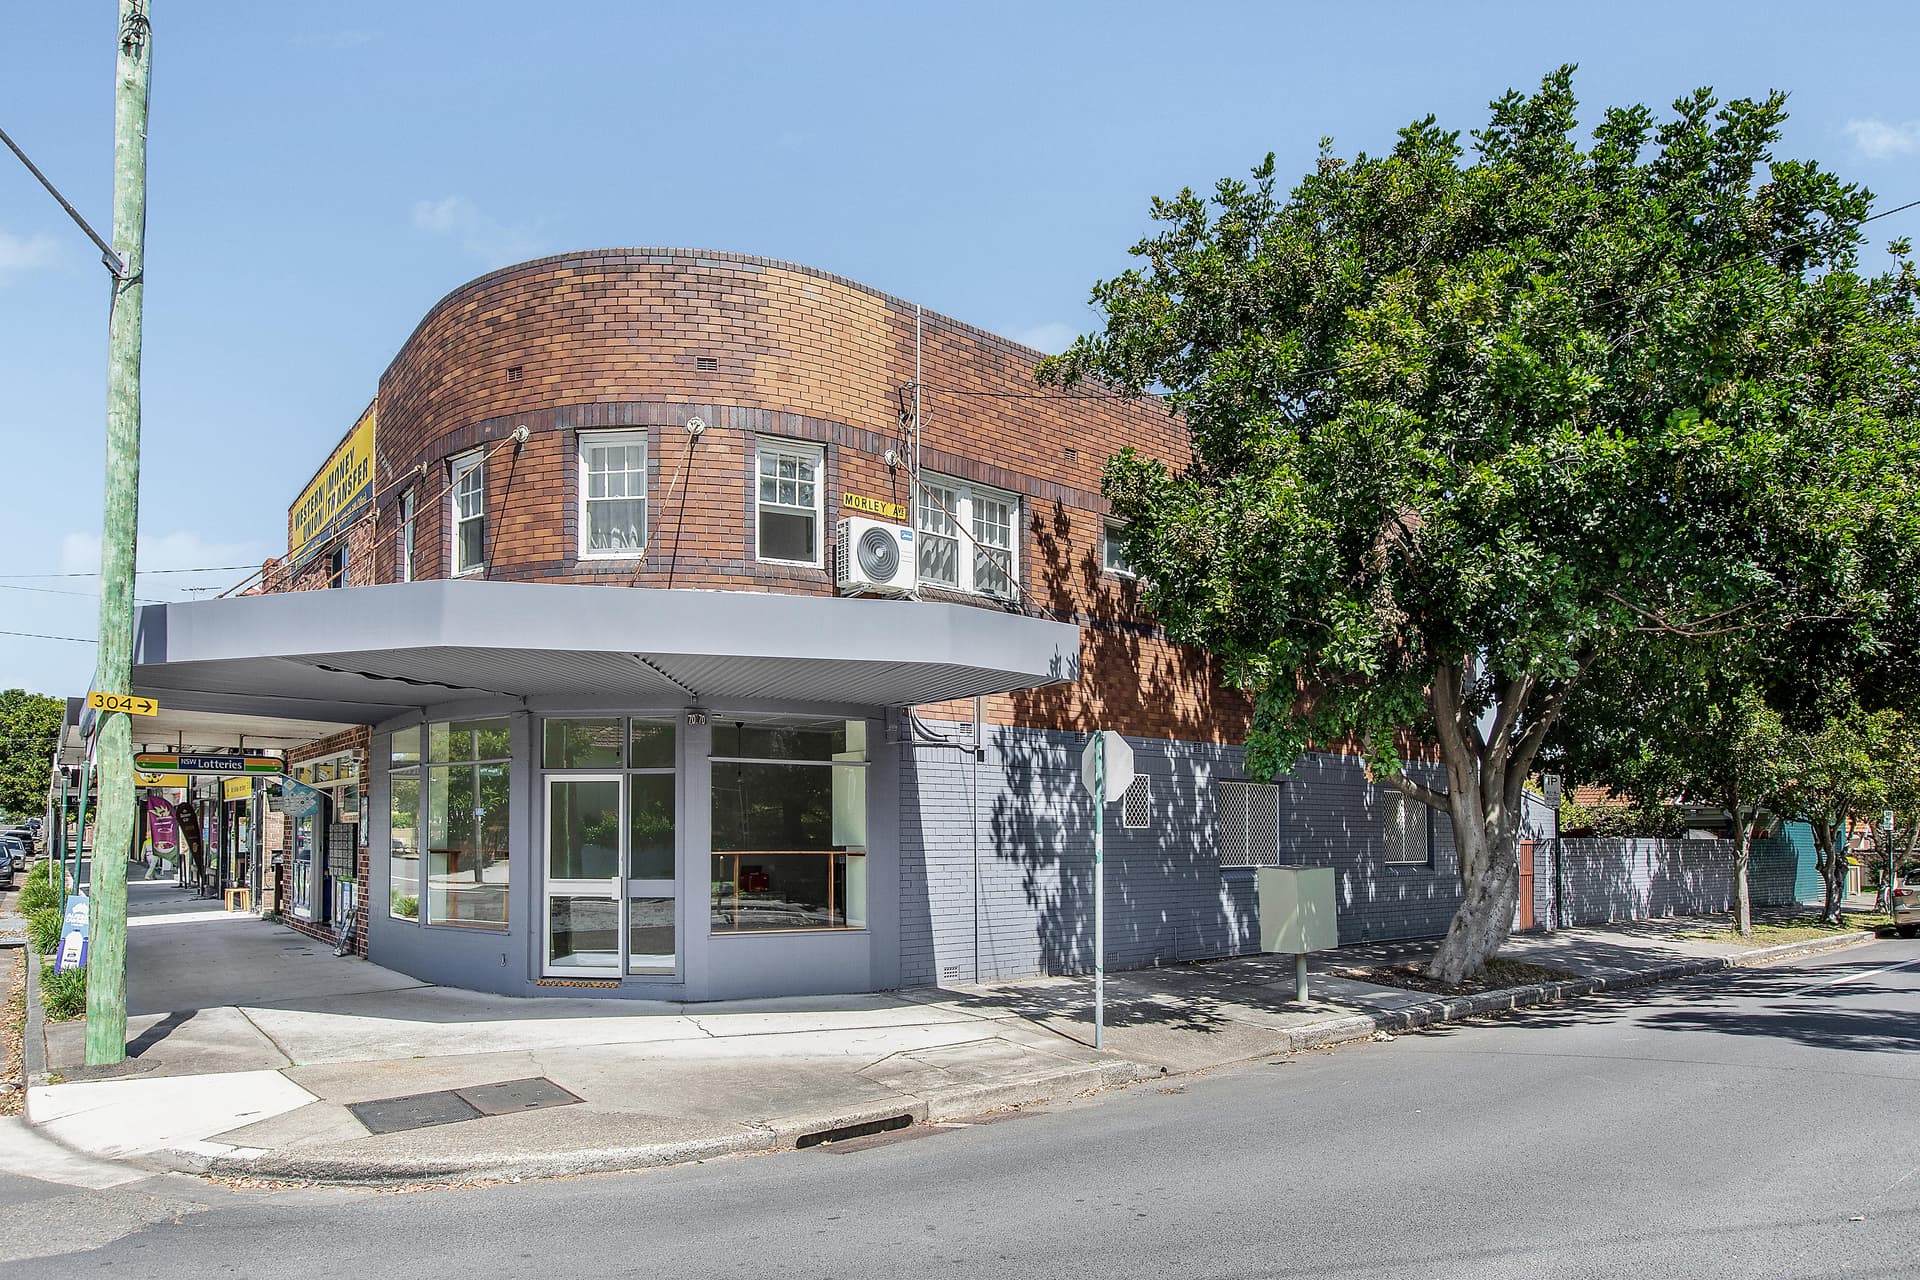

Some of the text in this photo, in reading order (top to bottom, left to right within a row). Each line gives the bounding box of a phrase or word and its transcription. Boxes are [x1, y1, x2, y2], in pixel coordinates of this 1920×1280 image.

[327, 446, 355, 492] MONEY
[327, 457, 368, 516] TRANSFER
[295, 483, 324, 531] WESTERN
[845, 494, 905, 517] MORLEY AVE
[303, 507, 323, 542] UNION
[94, 694, 133, 711] 304
[180, 757, 243, 771] NSW Lotteries
